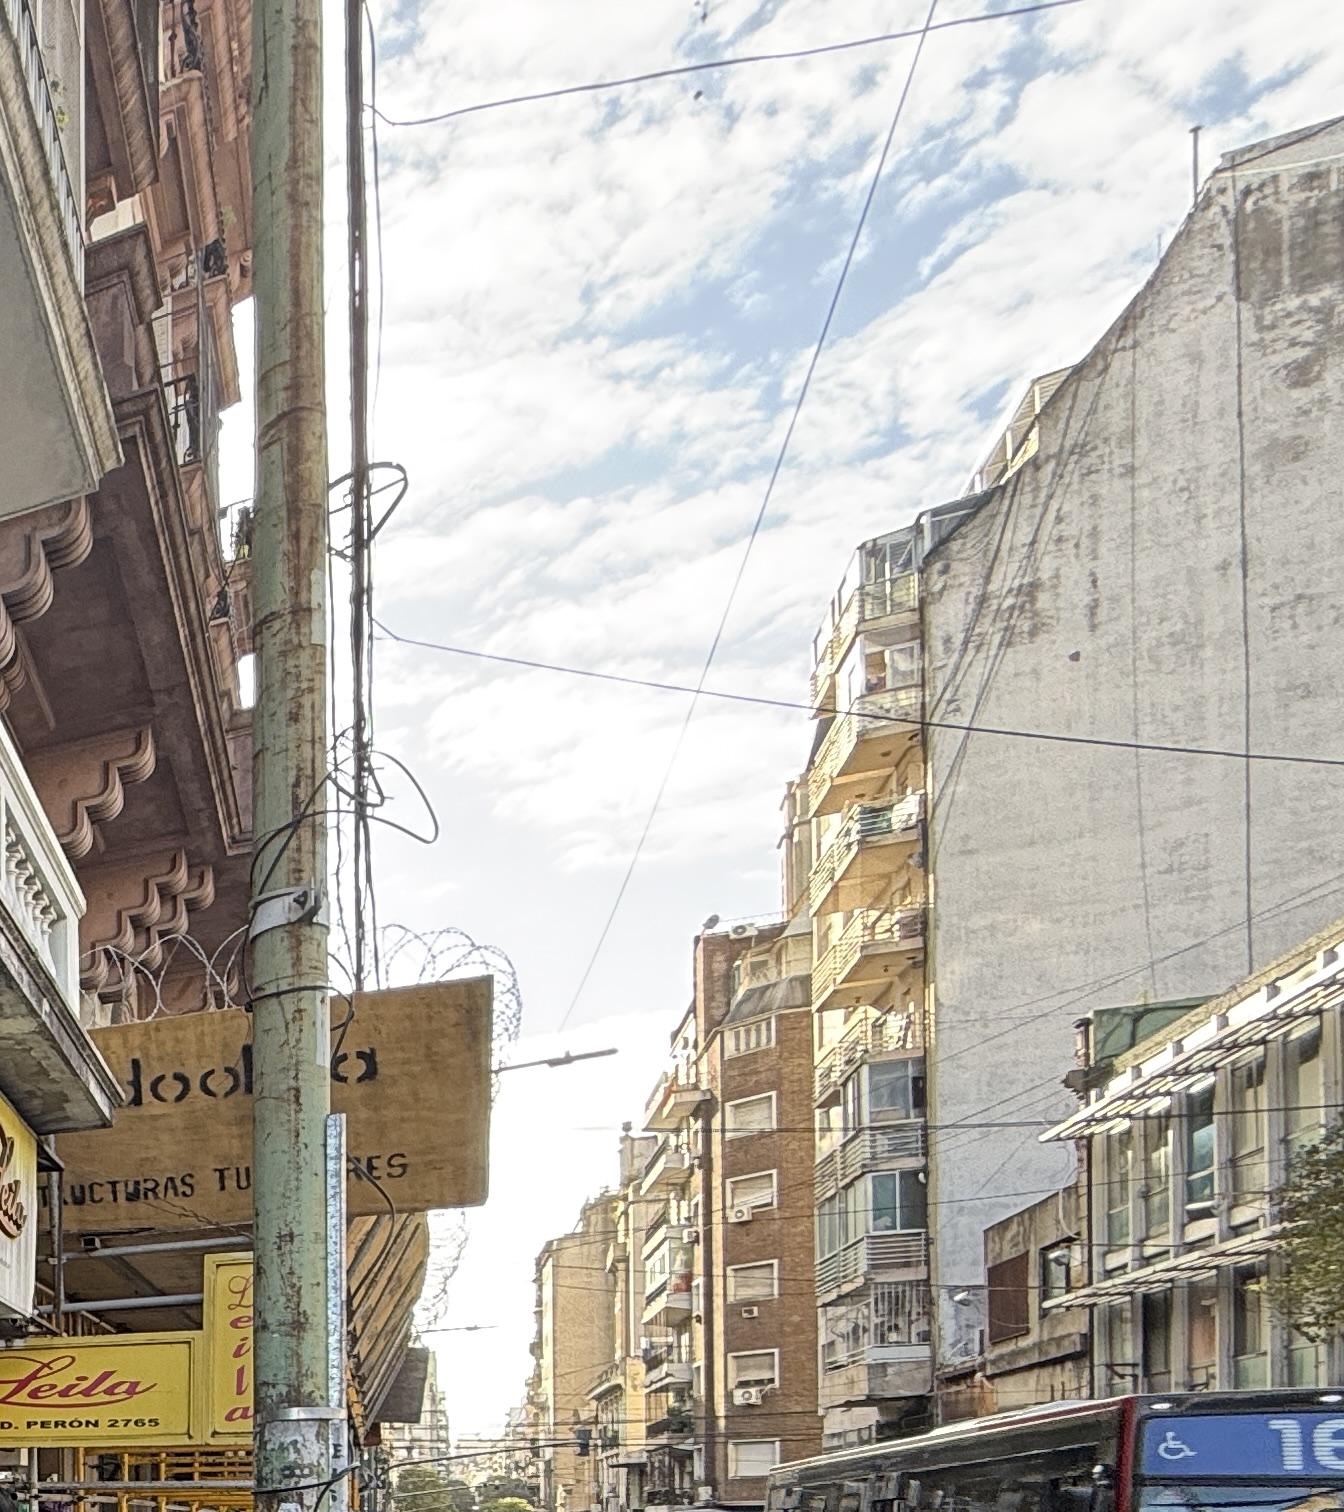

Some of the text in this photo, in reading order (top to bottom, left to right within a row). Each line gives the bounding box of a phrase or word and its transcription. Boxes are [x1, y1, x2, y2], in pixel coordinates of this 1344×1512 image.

[0, 1420, 19, 1430] D.
[26, 1417, 99, 1429] PERÓN
[107, 1418, 160, 1428] 2765
